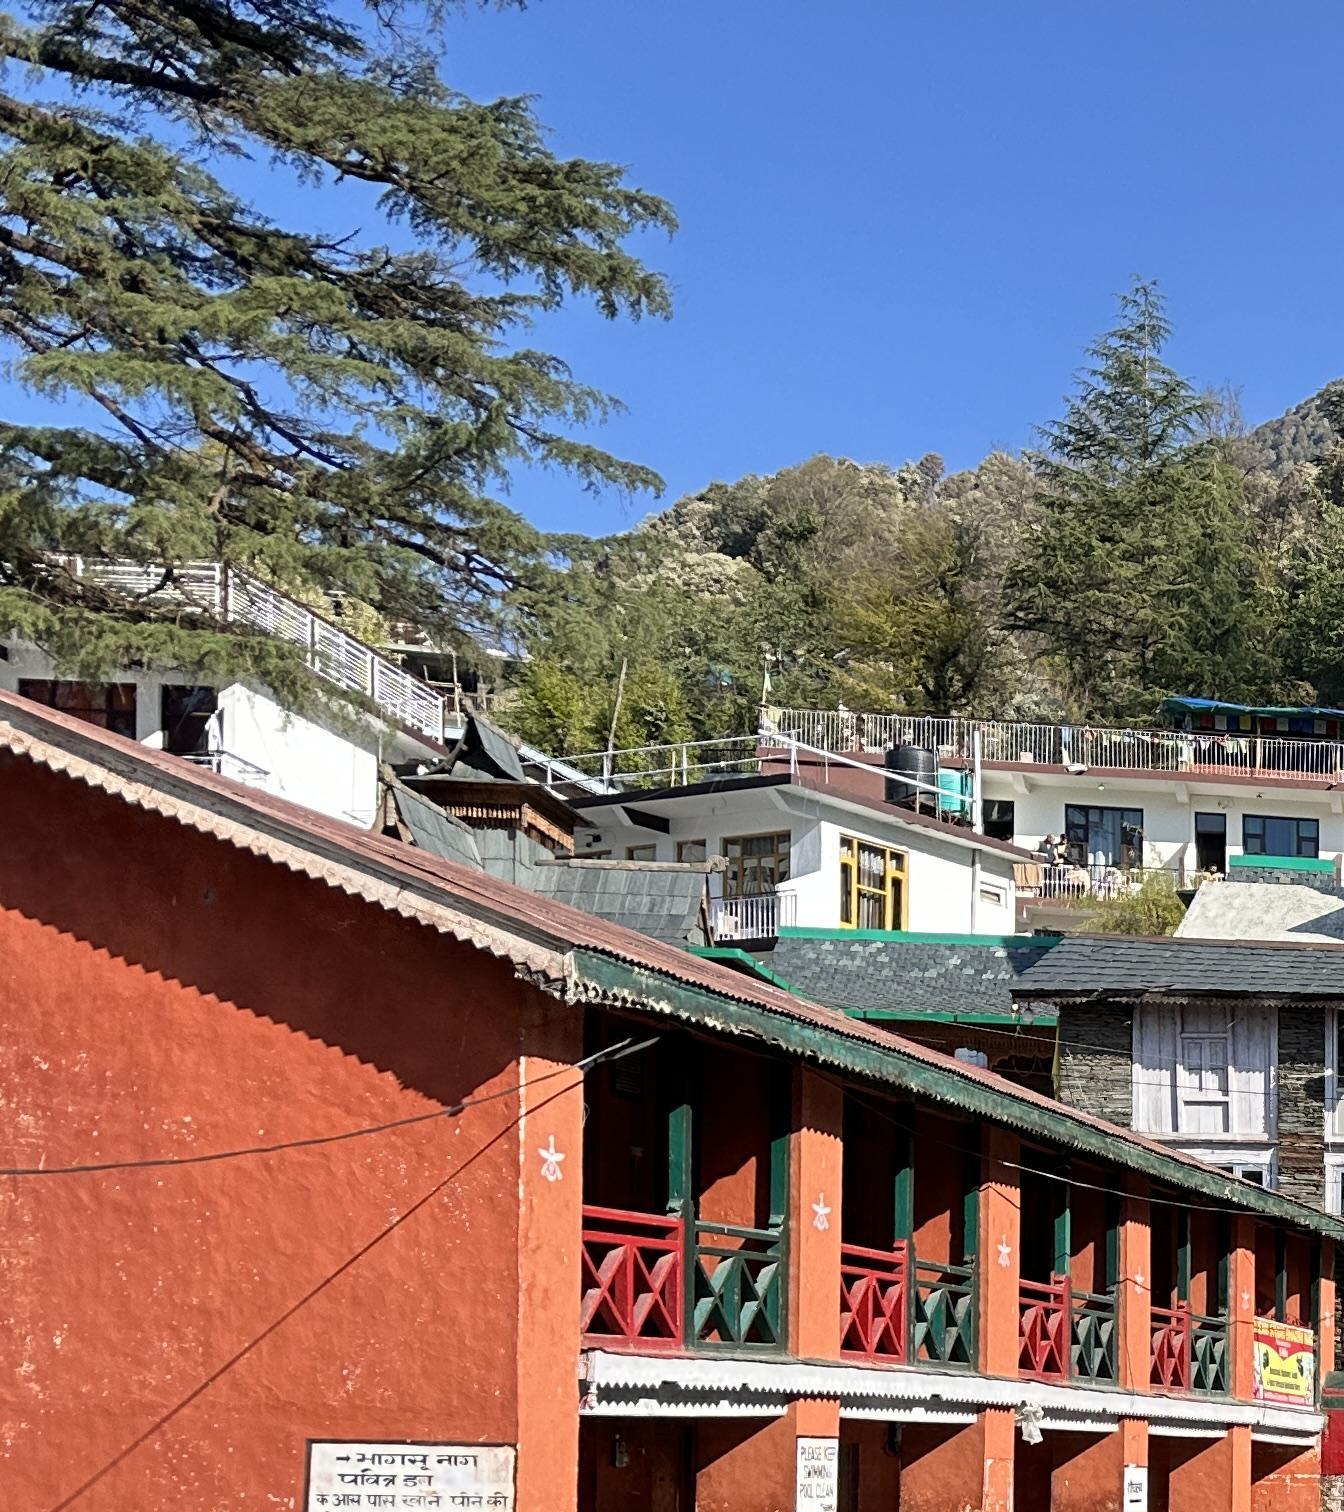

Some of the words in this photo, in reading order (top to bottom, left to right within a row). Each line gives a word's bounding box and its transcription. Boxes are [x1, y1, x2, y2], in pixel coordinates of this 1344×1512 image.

[356, 1452, 431, 1470] भागसू
[436, 1454, 479, 1468] नाग
[337, 1468, 397, 1487] पवित्र
[366, 1494, 396, 1507] पास
[486, 1491, 509, 1507] की
